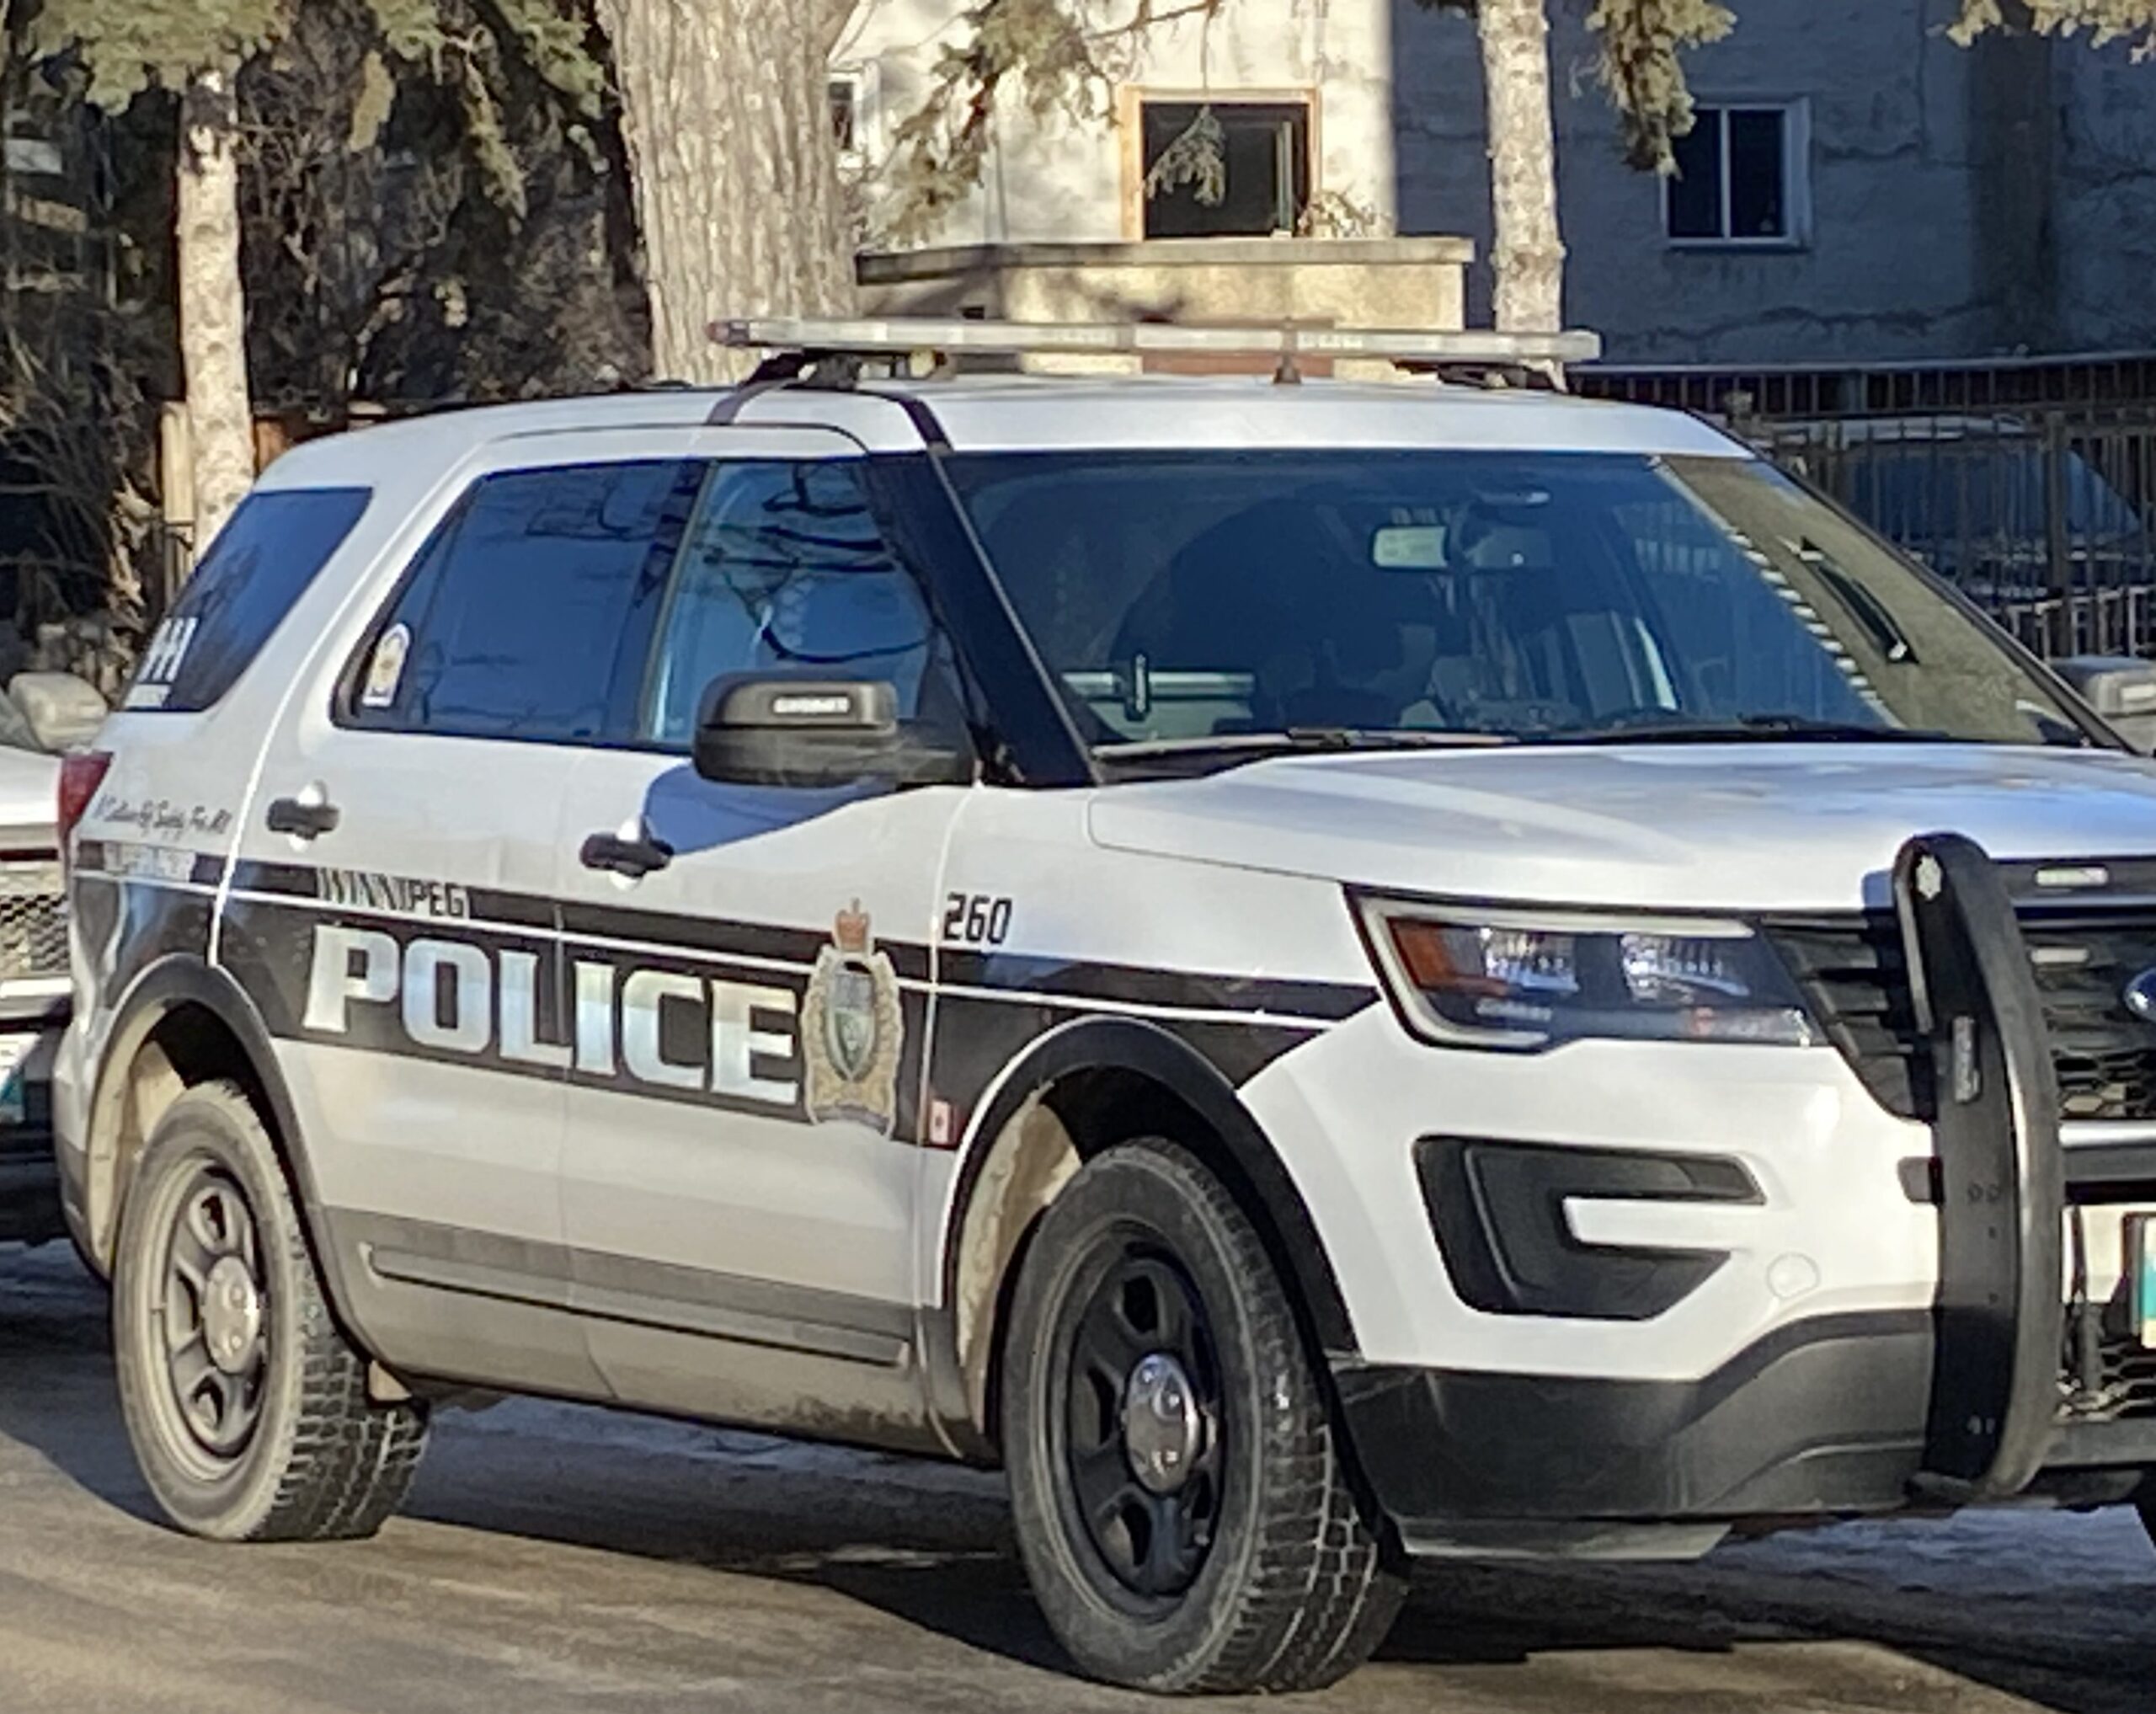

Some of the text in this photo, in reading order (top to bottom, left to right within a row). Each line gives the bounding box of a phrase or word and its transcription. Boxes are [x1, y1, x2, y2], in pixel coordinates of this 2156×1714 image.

[320, 868, 463, 916] WINNIPEG
[944, 893, 1012, 944] 260
[303, 925, 798, 1105] POLICE
